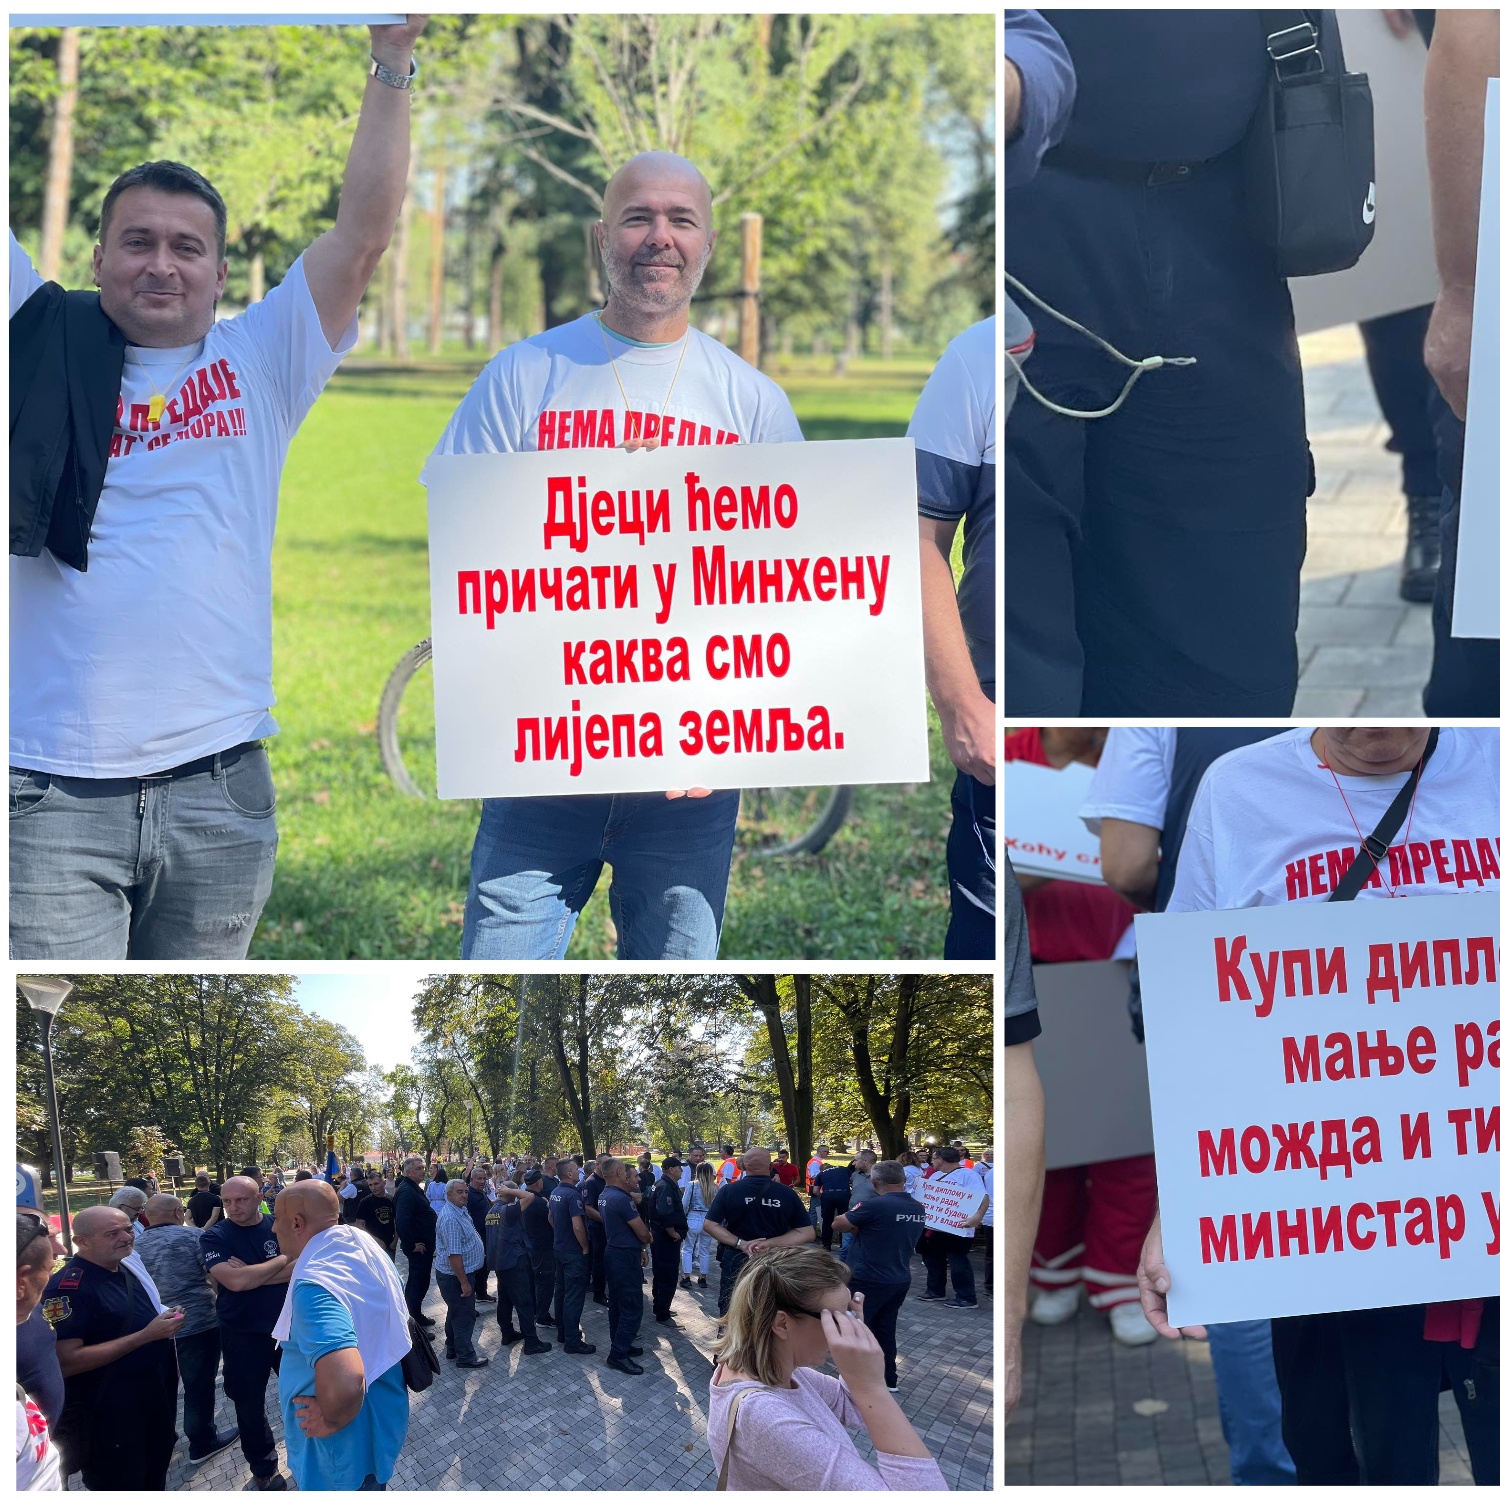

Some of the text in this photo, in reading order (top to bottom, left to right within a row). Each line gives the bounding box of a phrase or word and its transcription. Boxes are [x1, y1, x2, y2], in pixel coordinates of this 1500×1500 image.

[129, 358, 241, 432] ПЕДАЈЕ
[538, 409, 740, 451] НЕМА ПРЕДА
[543, 472, 798, 553] Дјеци ћемо
[458, 545, 890, 630] причати у Минхену
[563, 633, 790, 685] каква смо
[514, 699, 844, 777] лијепа земља.
[1215, 936, 1346, 1017] Купи
[1283, 1027, 1436, 1083] мање
[1199, 1117, 1381, 1179] можда
[1401, 1113, 1430, 1159] и
[744, 1197, 781, 1208] РЦЗ
[935, 1186, 966, 1200] диплому
[1200, 1195, 1465, 1263] министар
